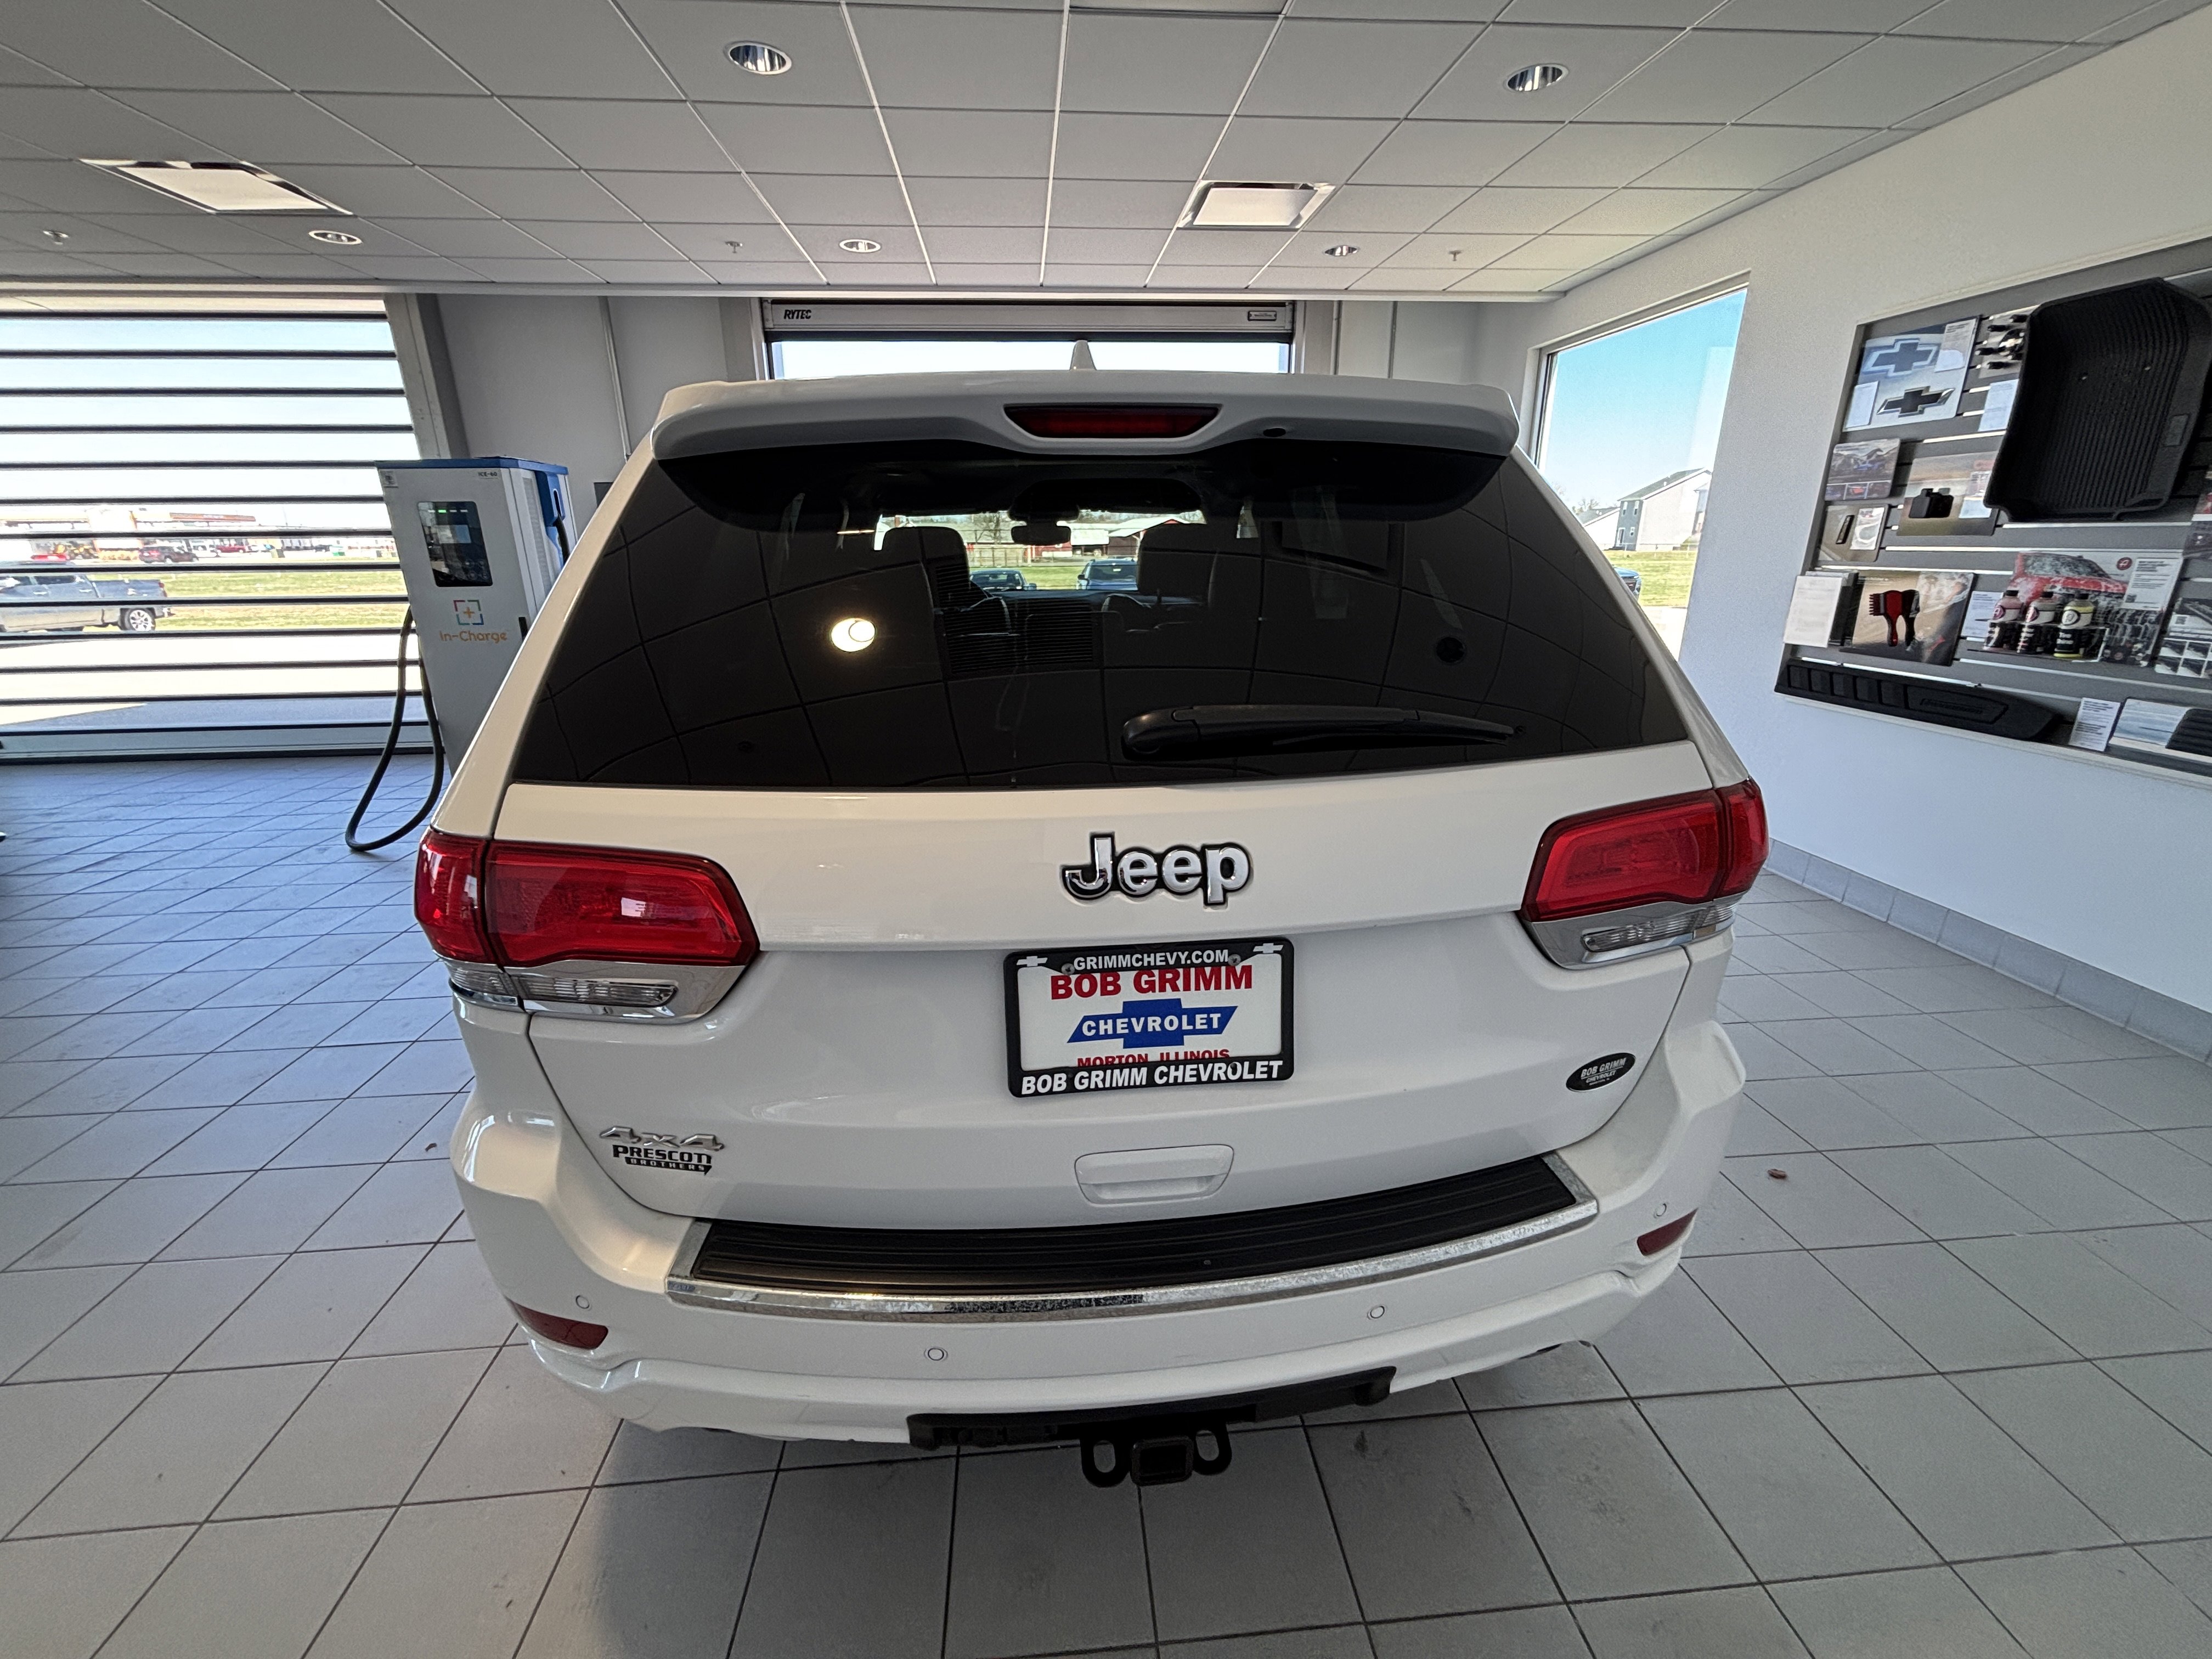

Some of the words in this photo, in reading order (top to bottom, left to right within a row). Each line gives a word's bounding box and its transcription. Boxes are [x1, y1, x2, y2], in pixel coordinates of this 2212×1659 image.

[784, 309, 811, 319] RYTEC
[439, 630, 507, 644] In-Charge
[1063, 834, 1251, 905] Jeep
[1073, 949, 1229, 970] GRIMMCHEVY.COM
[1051, 972, 1121, 1000] BOB
[1133, 965, 1252, 994] GRIMM
[1082, 1013, 1222, 1037] CHEVROLET
[1022, 1073, 1067, 1095] BOB
[1074, 1067, 1148, 1090] GRIMM
[1154, 1060, 1283, 1085] CHEVROLET
[1581, 1065, 1599, 1077] BOB
[612, 1144, 712, 1164] PRESCOTT
[630, 1158, 706, 1171] BROTHERS
